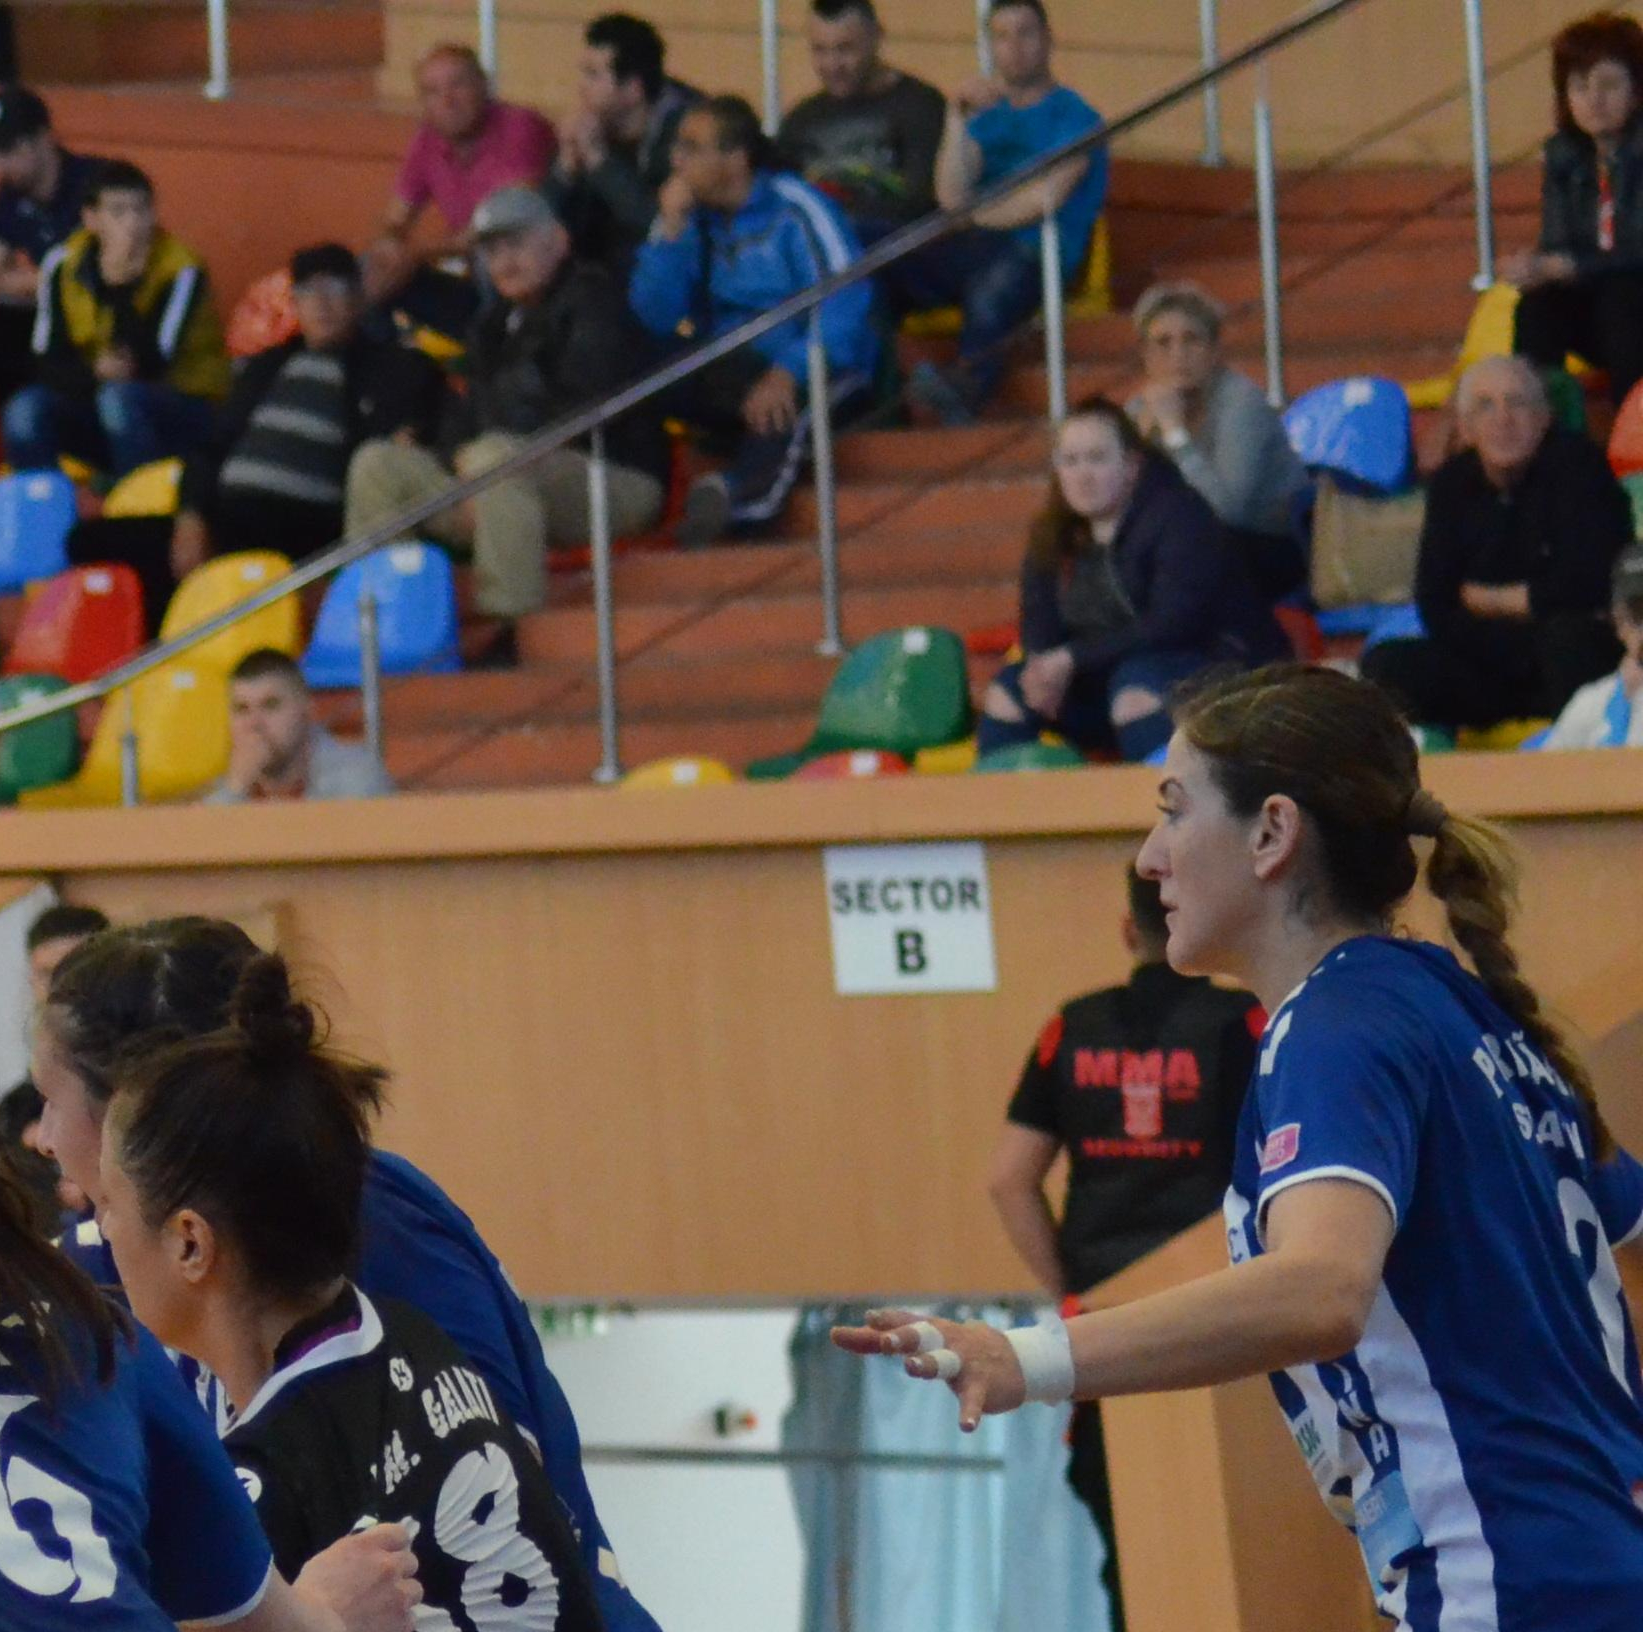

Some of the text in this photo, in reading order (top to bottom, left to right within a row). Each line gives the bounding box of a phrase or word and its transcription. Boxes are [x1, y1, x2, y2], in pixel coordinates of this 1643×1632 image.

[831, 877, 981, 914] SECTOR
[895, 928, 927, 975] B
[1074, 1049, 1201, 1089] MMA
